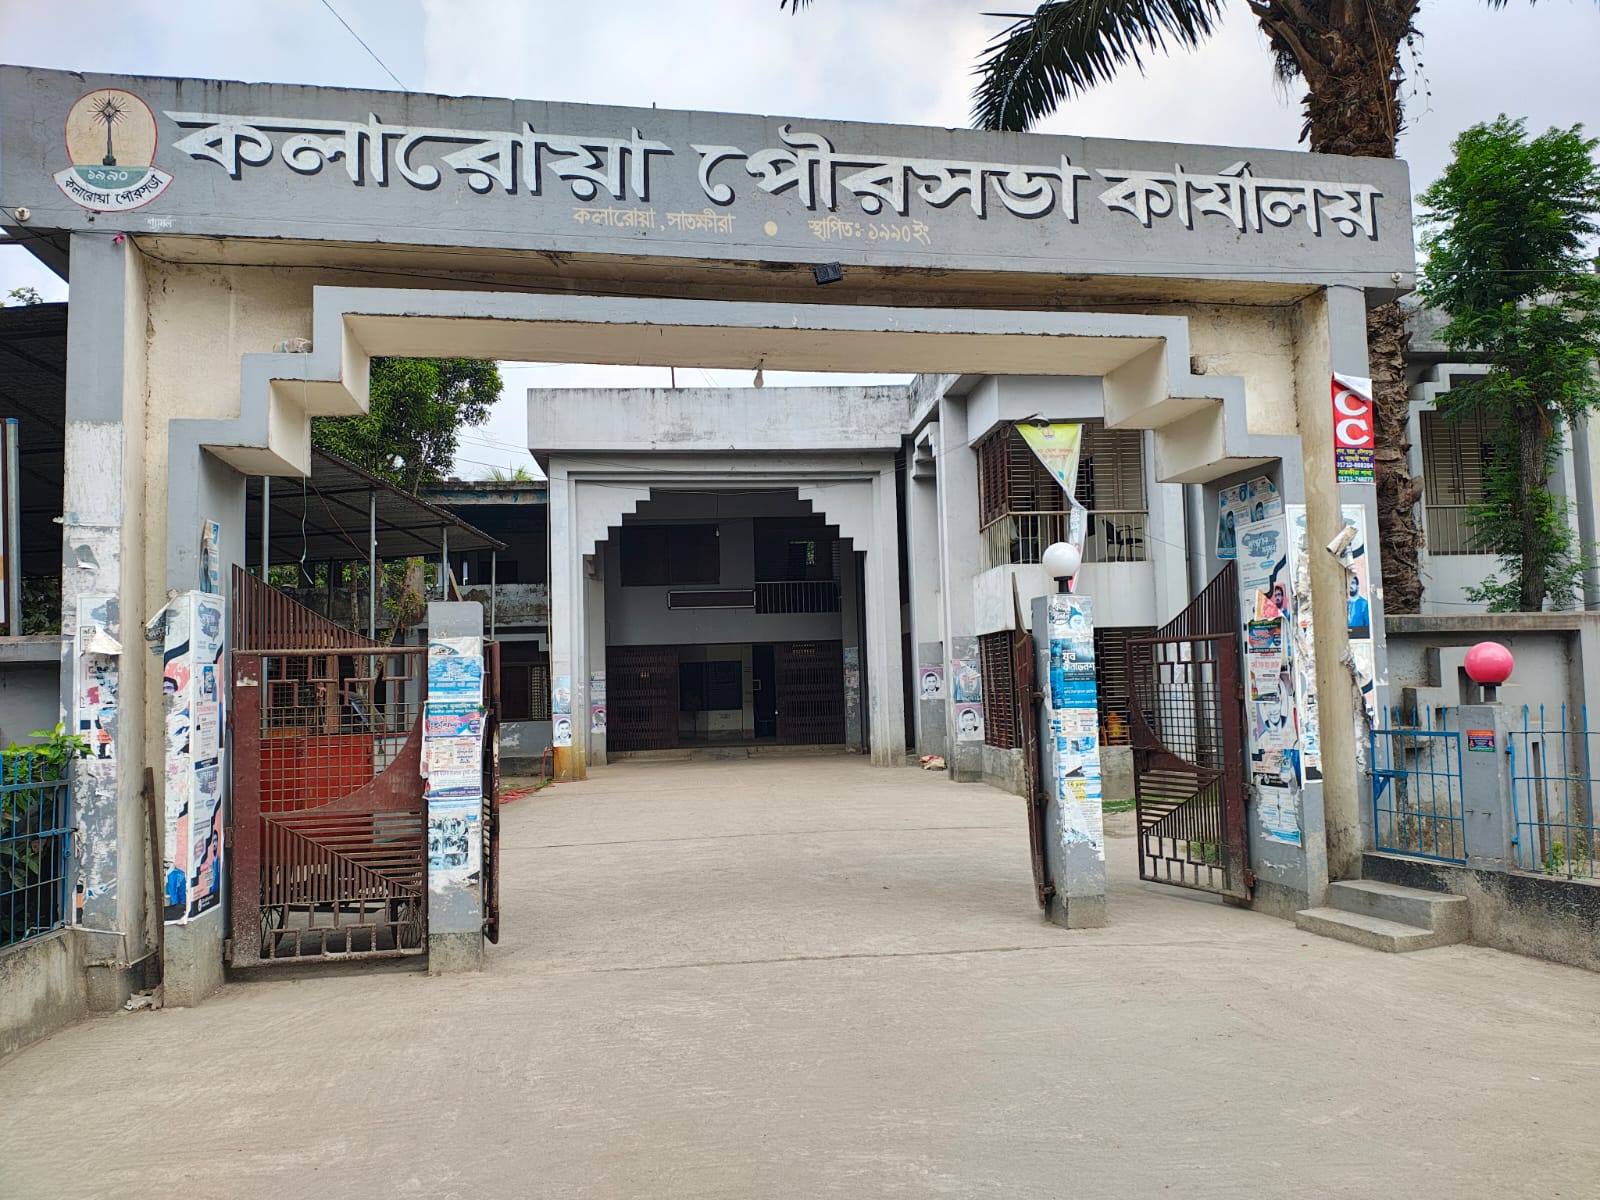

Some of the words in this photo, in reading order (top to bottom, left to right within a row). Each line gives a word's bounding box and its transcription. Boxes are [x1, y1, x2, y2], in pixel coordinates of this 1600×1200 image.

[65, 175, 110, 204] কলারোয়া
[115, 173, 163, 204] পৌরসভা
[87, 170, 128, 181] ১৯৯০
[162, 111, 675, 202] কলারোয়া
[689, 123, 1091, 225] পৌরসভা
[1095, 161, 1384, 241] কার্যালয়
